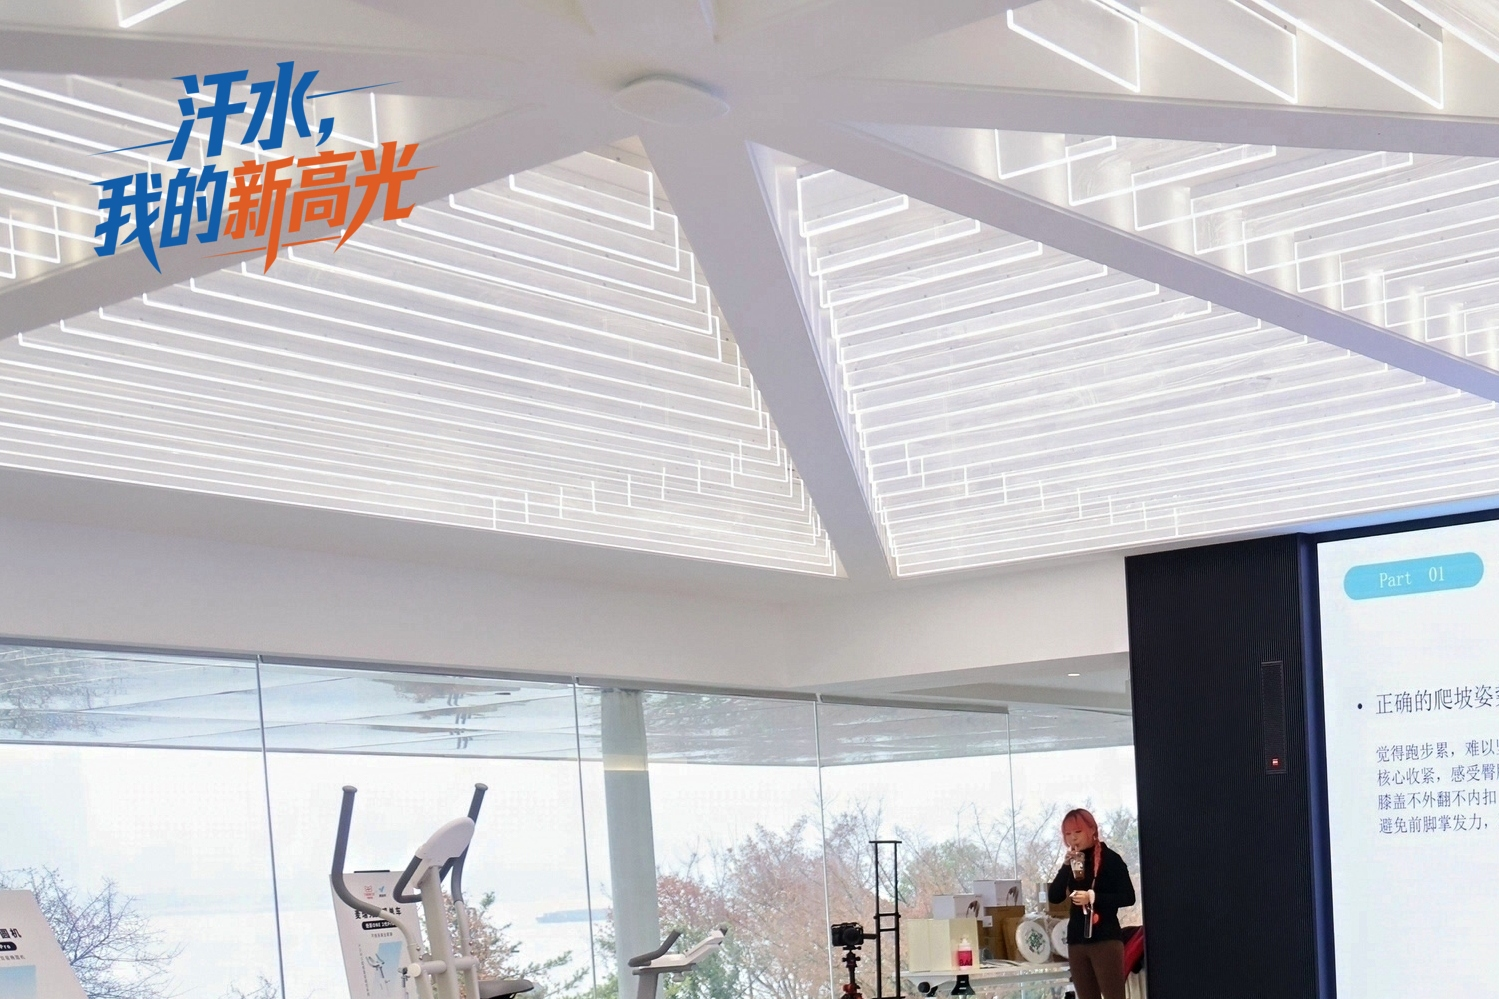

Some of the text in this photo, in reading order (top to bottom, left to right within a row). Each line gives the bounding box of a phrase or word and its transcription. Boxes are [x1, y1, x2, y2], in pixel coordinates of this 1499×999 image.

[1379, 566, 1446, 588] Part 01
[1377, 789, 1497, 811] 膝盖不外翻不内扣
